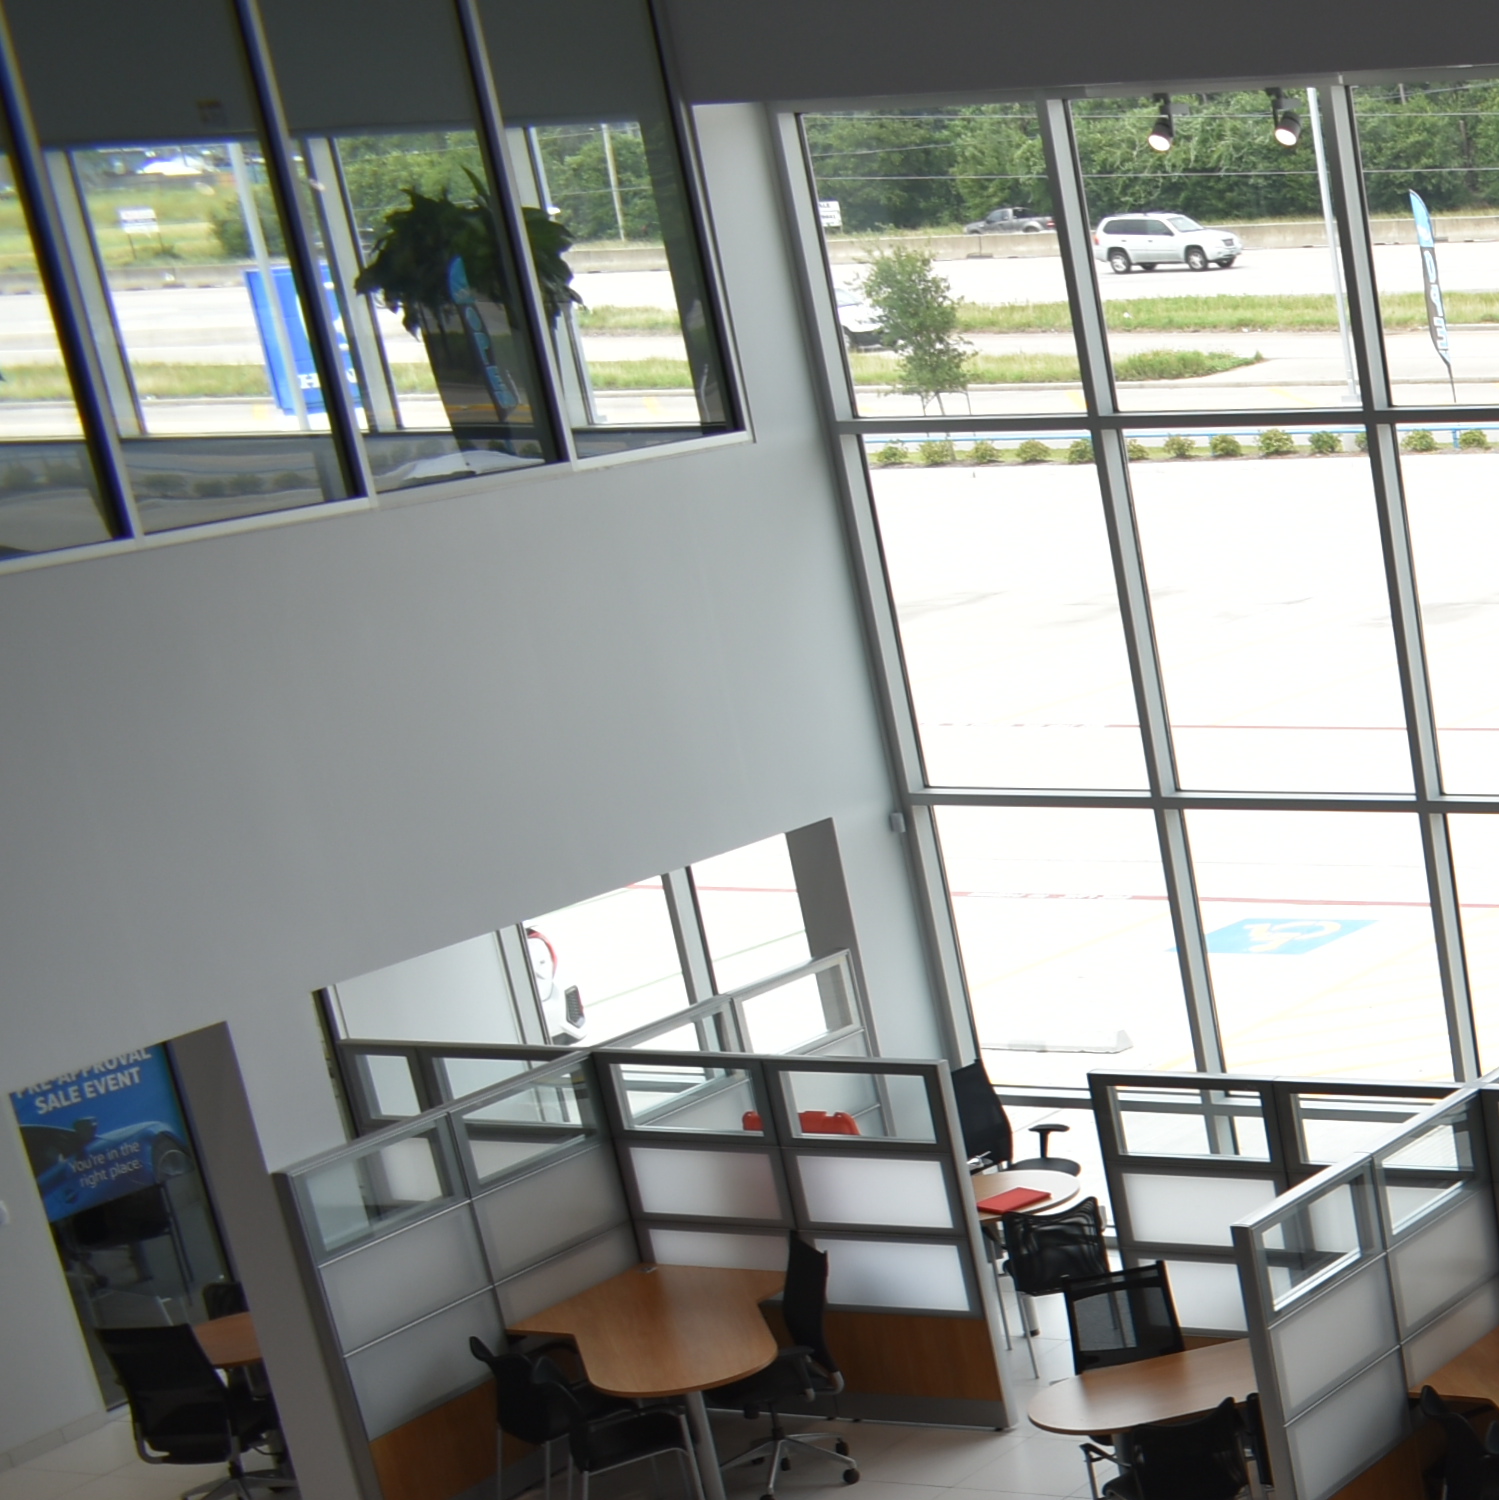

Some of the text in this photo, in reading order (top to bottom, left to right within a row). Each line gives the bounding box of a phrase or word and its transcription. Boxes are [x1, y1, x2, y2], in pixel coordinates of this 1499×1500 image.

[35, 1067, 141, 1114] SALE EVENT
[70, 1141, 141, 1173] You're in the
[80, 1170, 108, 1189] right
